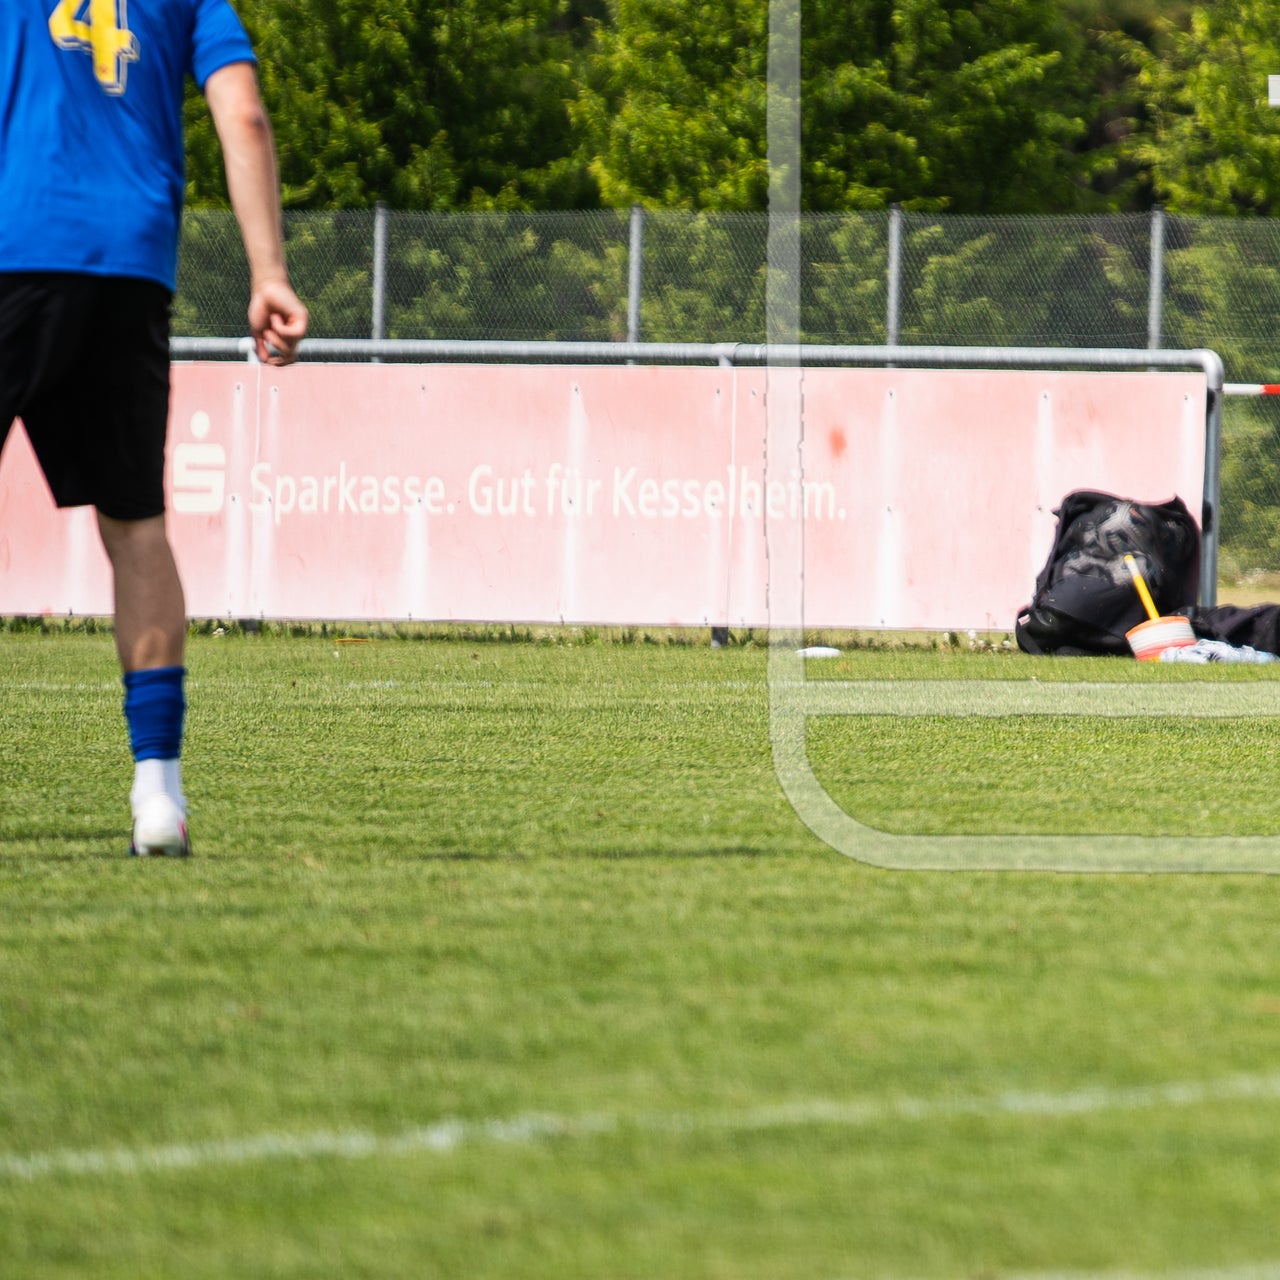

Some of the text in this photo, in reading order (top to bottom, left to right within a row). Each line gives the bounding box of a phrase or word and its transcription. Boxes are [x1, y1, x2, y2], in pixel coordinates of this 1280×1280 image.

[250, 461, 848, 524] Sparkasse. Gut für Kesselheim.
